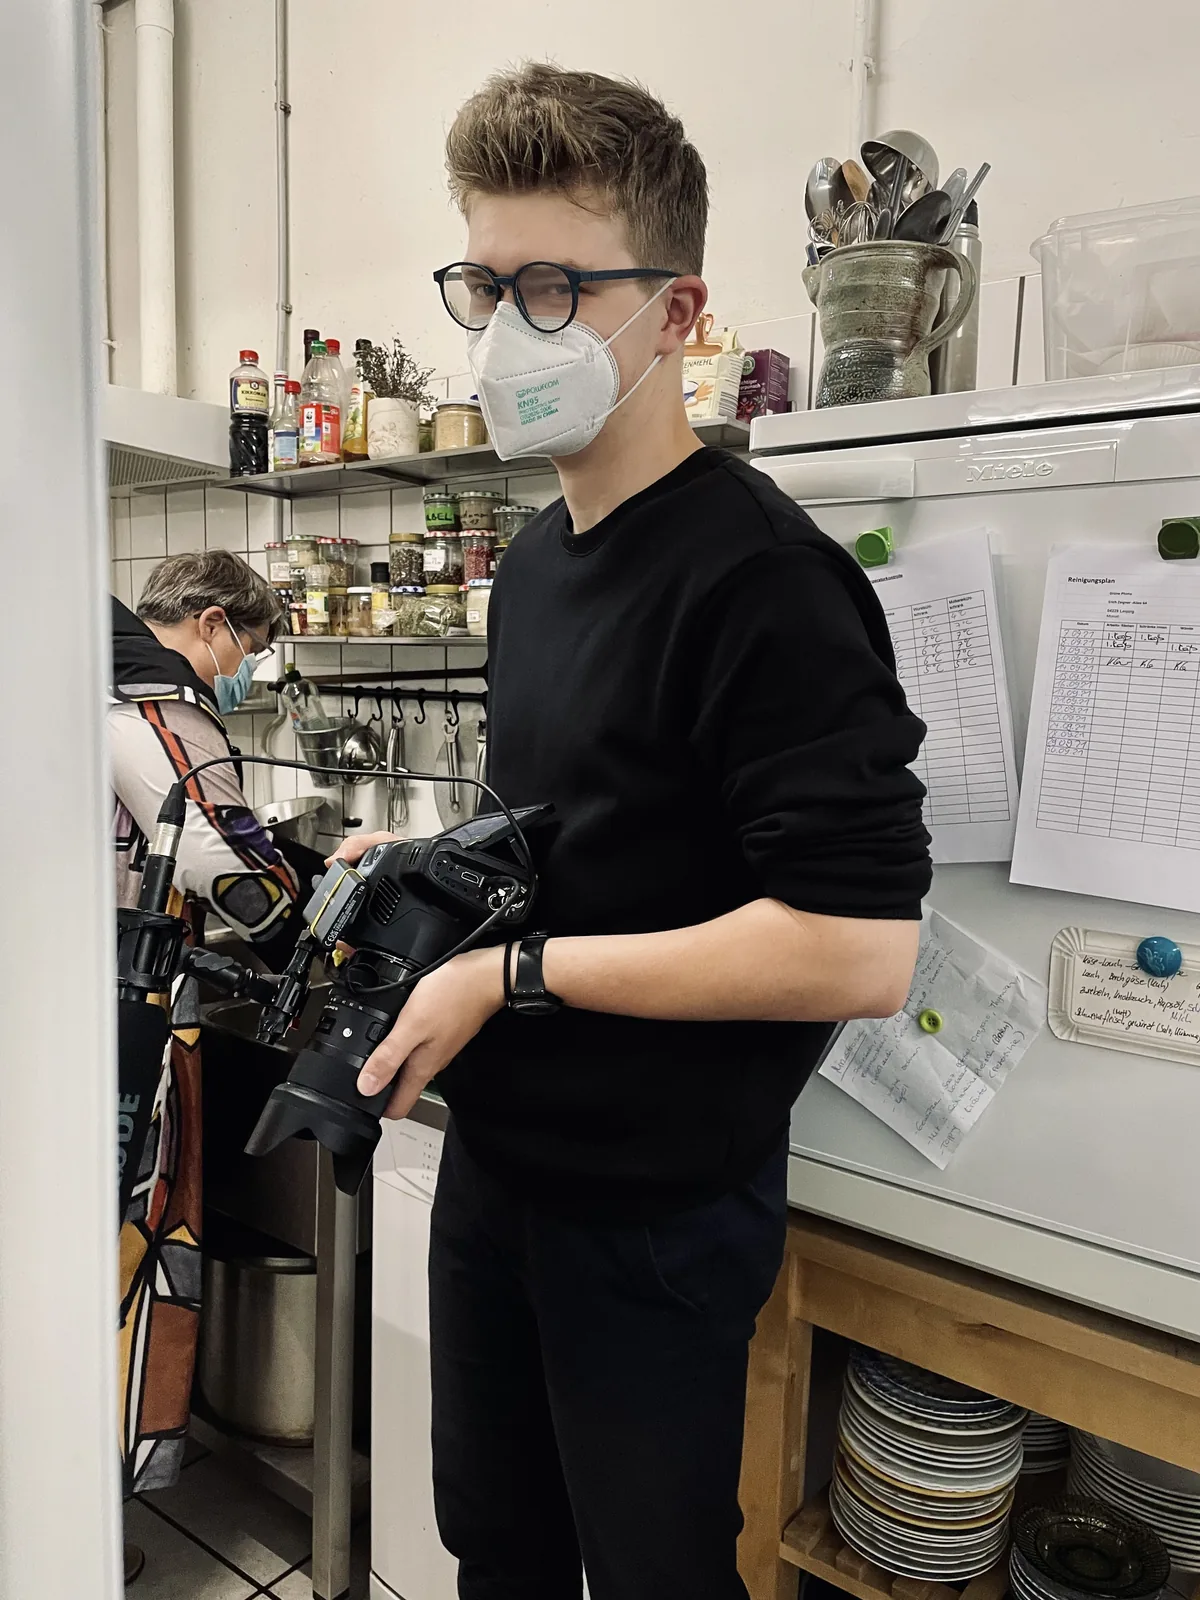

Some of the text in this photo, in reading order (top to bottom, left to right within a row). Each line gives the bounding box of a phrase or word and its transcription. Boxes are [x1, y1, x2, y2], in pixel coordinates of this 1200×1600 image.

[684, 358, 713, 369] ENMEHL
[517, 396, 539, 410] KN95
[543, 408, 559, 417] CHINA
[966, 460, 1053, 482] Miele
